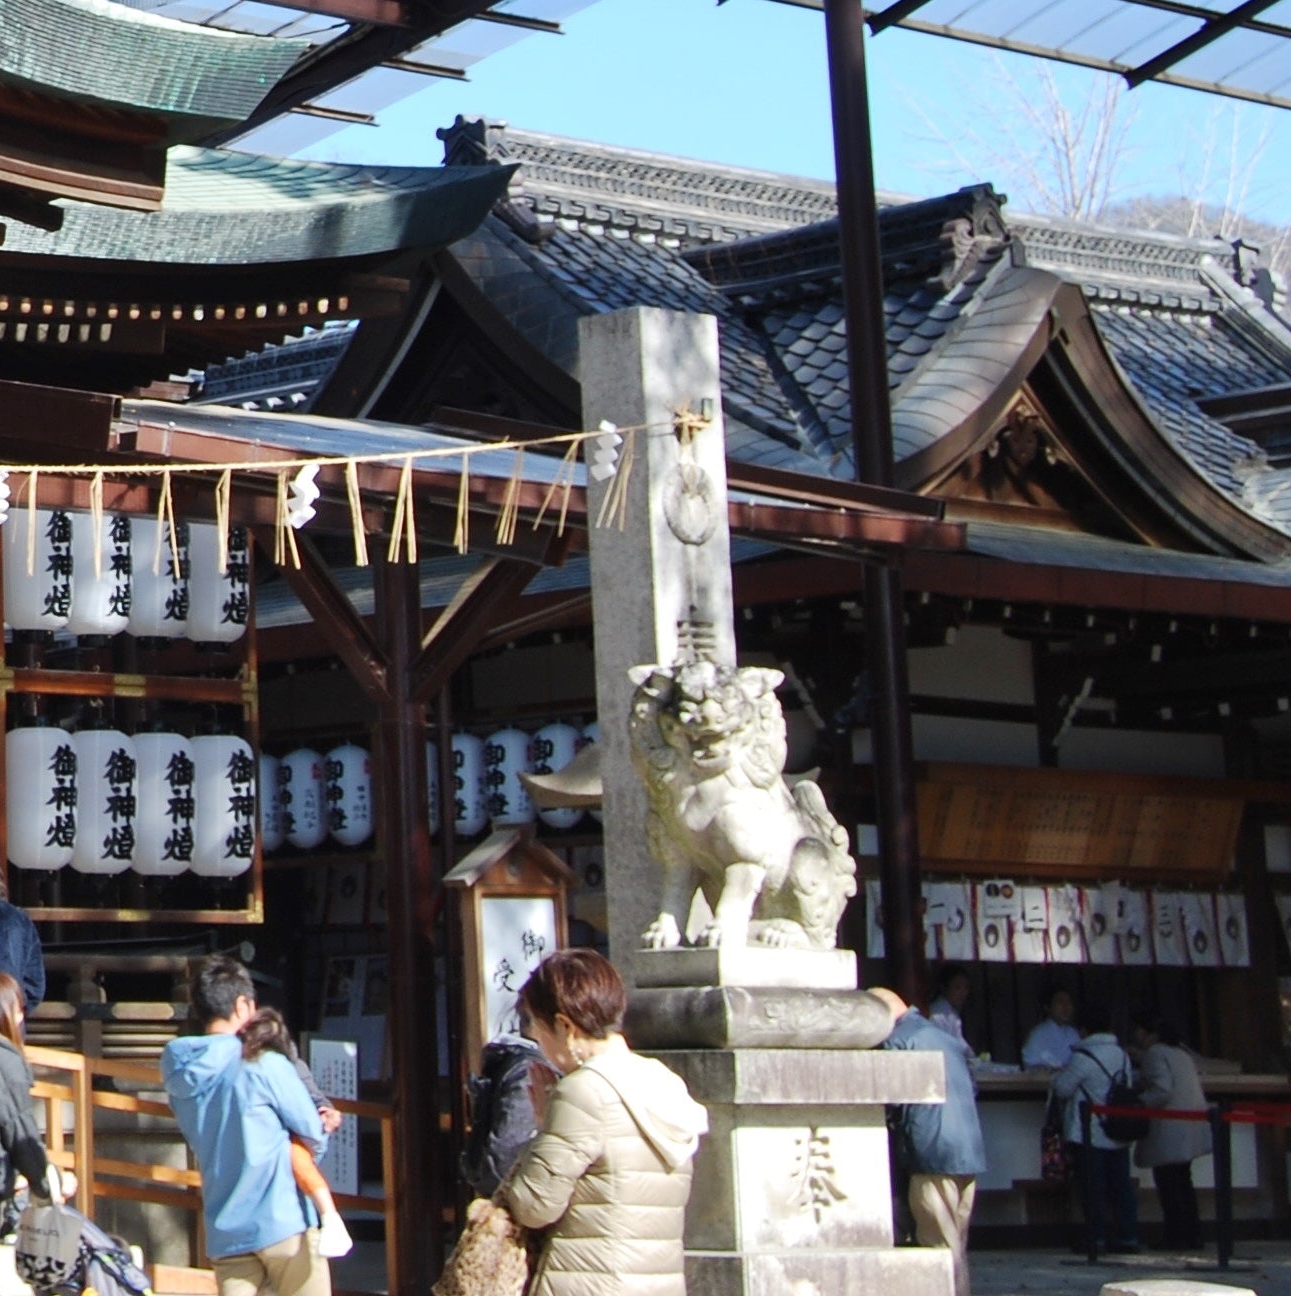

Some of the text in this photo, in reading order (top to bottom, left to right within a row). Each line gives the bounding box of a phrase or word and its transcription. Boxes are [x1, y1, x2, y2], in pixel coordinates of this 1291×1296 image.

[41, 510, 74, 618] 御神燈
[45, 744, 78, 849] 御神燈
[101, 747, 137, 861] 御神燈
[161, 750, 195, 862] 御神燈
[224, 749, 255, 859] 御神燈
[785, 1122, 848, 1225] 奉
